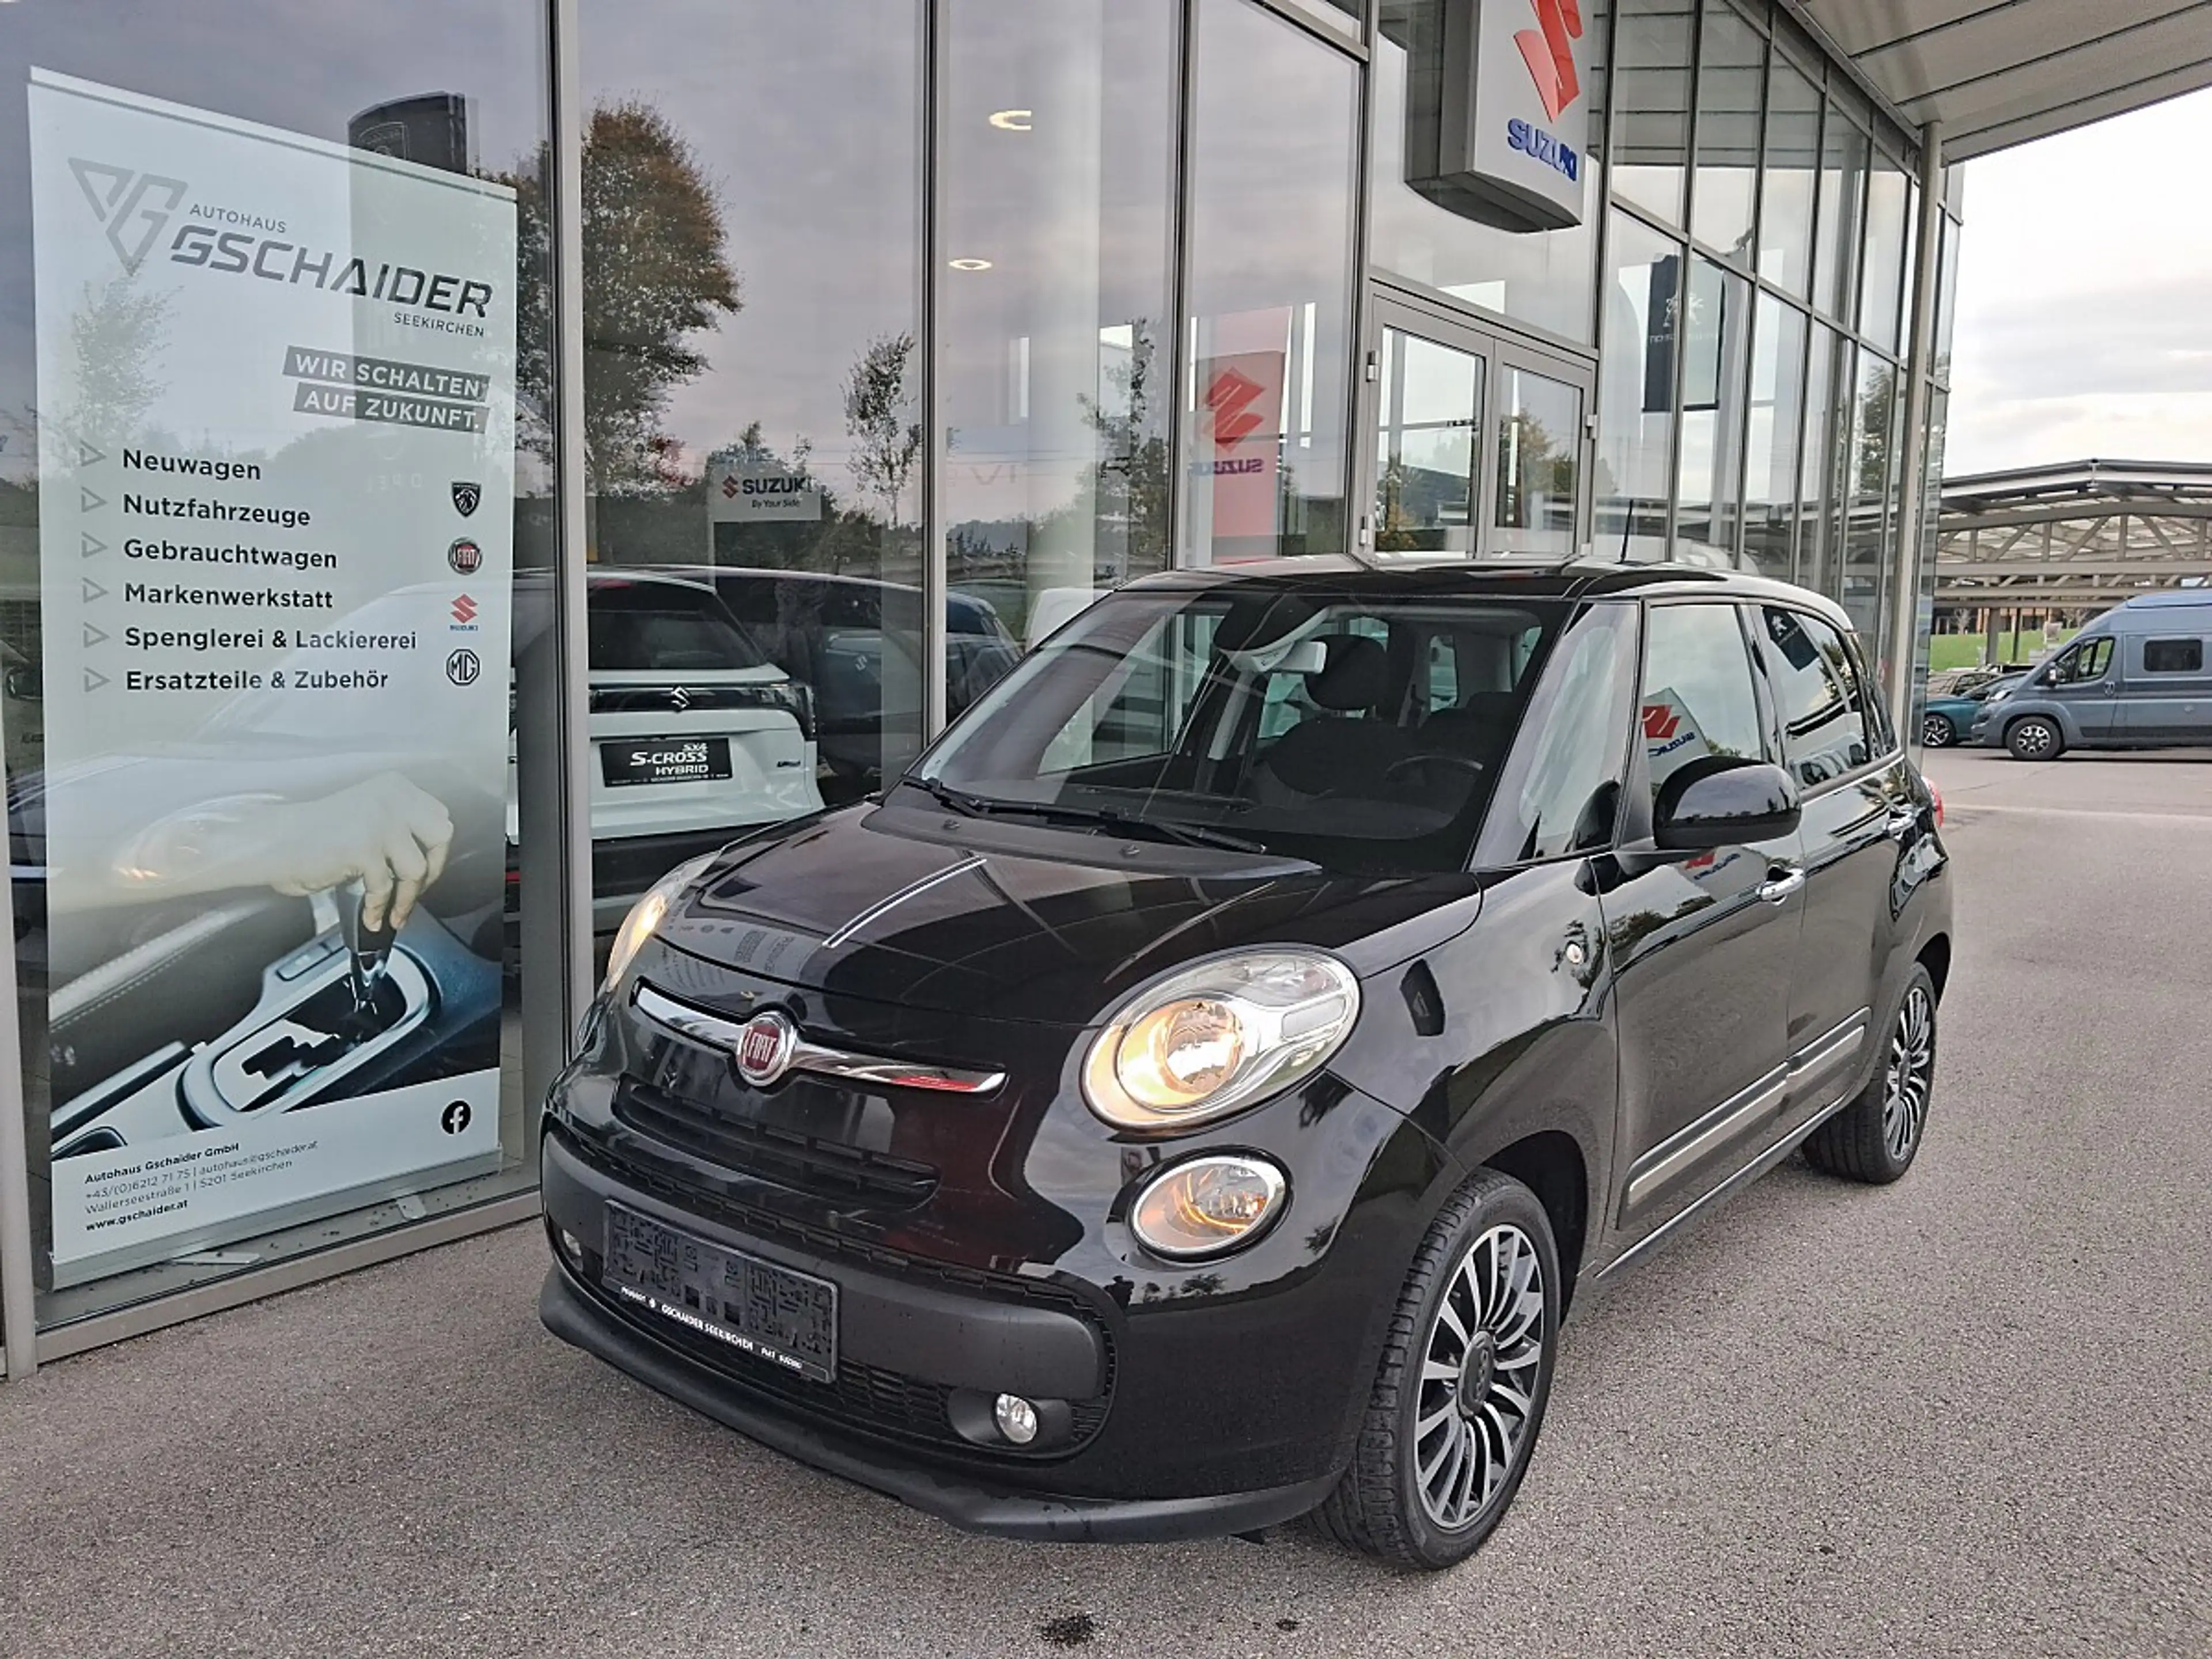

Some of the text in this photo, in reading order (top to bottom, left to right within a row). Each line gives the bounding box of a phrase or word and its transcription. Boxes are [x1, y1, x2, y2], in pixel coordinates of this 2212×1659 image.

[1508, 118, 1577, 181] SUZUKI
[189, 204, 287, 233] AUTOHAUS
[171, 225, 493, 318] GSCHAIDER
[394, 312, 484, 338] SEEKIRCHEN
[294, 353, 479, 397] WIR SCHALTEN
[303, 391, 479, 429] AUF ZUKUNFT.
[123, 449, 260, 480] Neuwagen
[742, 477, 812, 494] SUZUKI
[123, 494, 311, 528] Nutzfahrzeuge
[124, 538, 337, 570] Gebrauchtwagen
[124, 583, 333, 608] Markenwerkstatt
[125, 627, 417, 650] Spenglerei & Lackiererei
[126, 670, 389, 691] Ersatzteile & Zubehör
[629, 751, 708, 767] S-CROSS
[656, 764, 710, 776] HYBRID
[748, 1031, 778, 1063] FIAT
[84, 1142, 239, 1184] Autohaus Gschaider GmbH
[86, 1199, 188, 1232] www.gschaider.at
